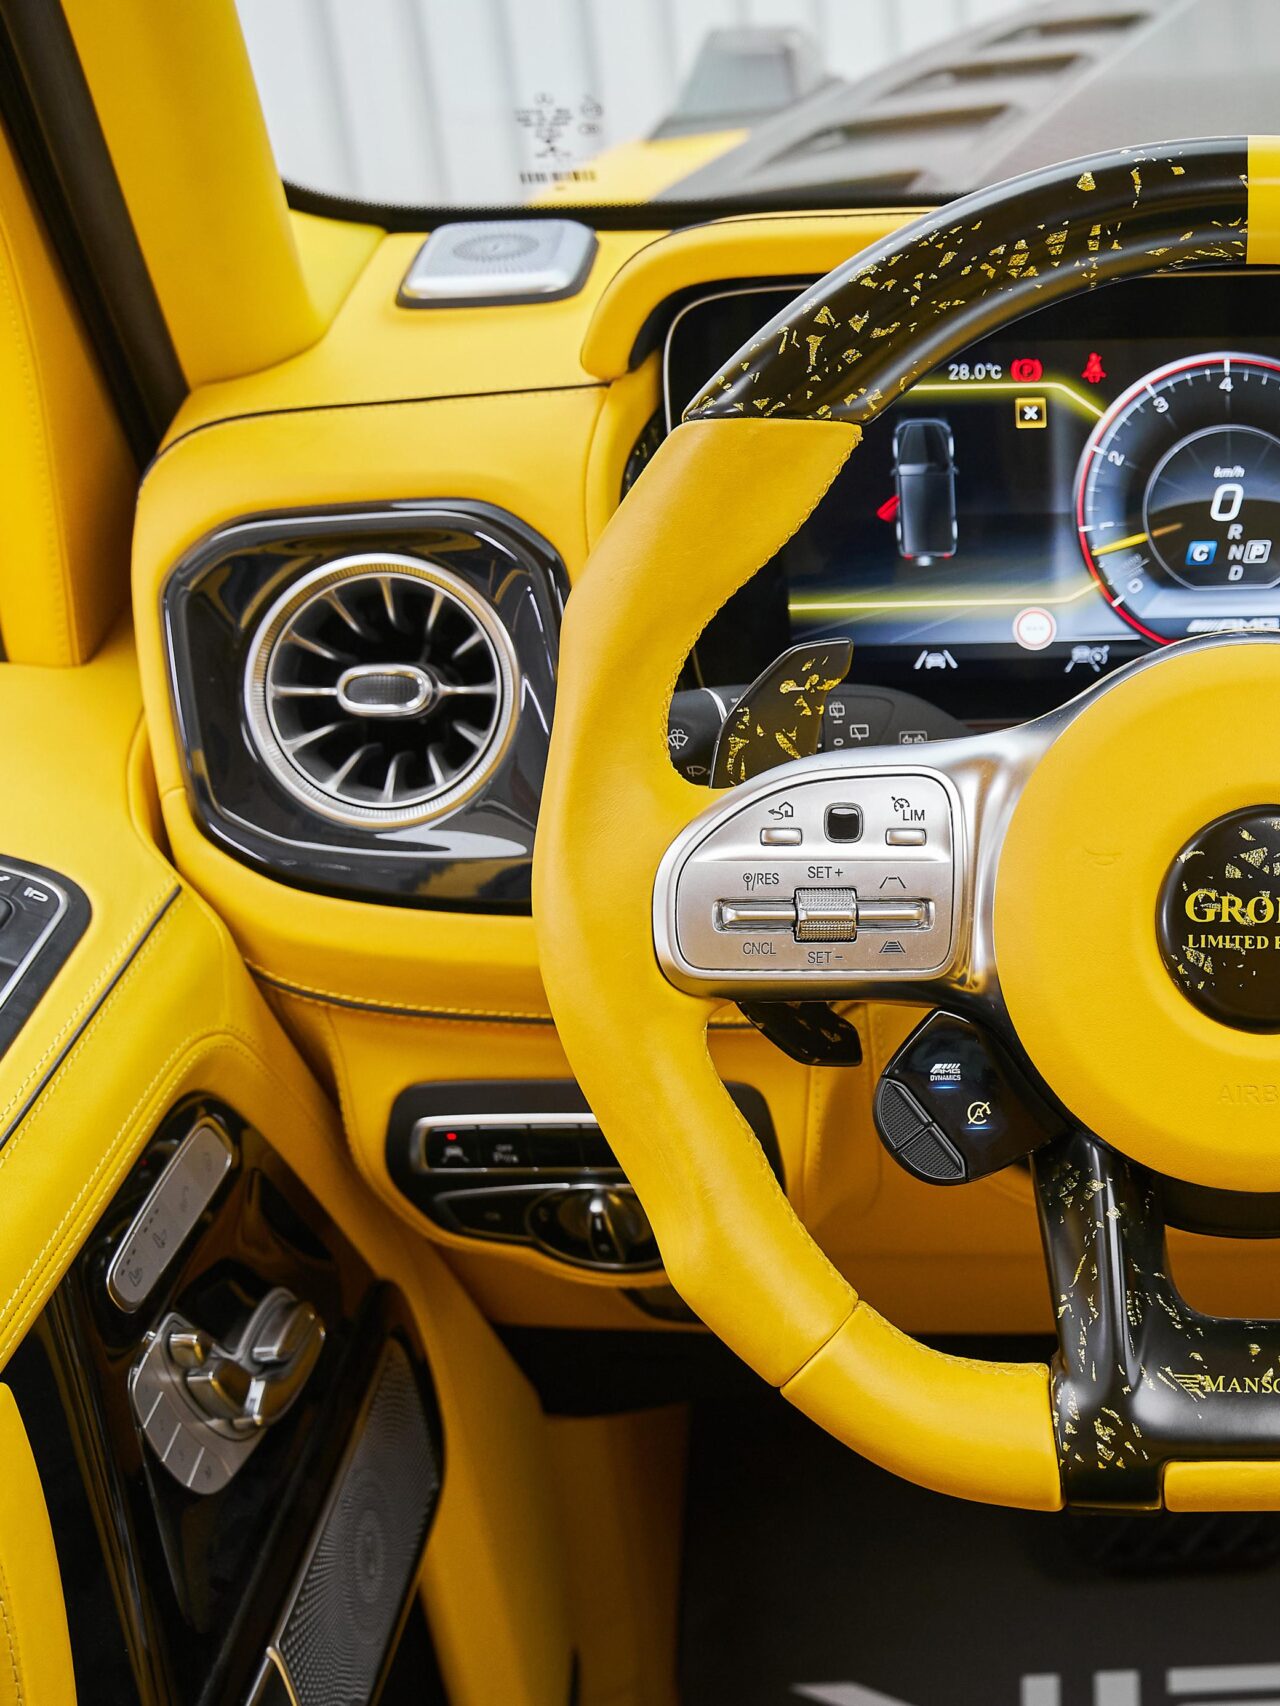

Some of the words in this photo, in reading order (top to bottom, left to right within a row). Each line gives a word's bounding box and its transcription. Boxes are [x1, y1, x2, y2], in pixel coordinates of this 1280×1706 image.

[1218, 376, 1234, 392] 4
[1153, 396, 1170, 413] 3
[1107, 450, 1125, 466] 2
[1213, 466, 1245, 478] km/h
[1210, 483, 1244, 522] 0
[1227, 523, 1244, 540] R
[1192, 544, 1209, 562] C
[1228, 544, 1245, 561] N
[1248, 543, 1266, 560] P
[1228, 565, 1245, 581] D
[1127, 578, 1144, 594] 0
[902, 809, 925, 821] LIM
[743, 942, 777, 955] CNCL
[1187, 934, 1269, 950] LIMITED
